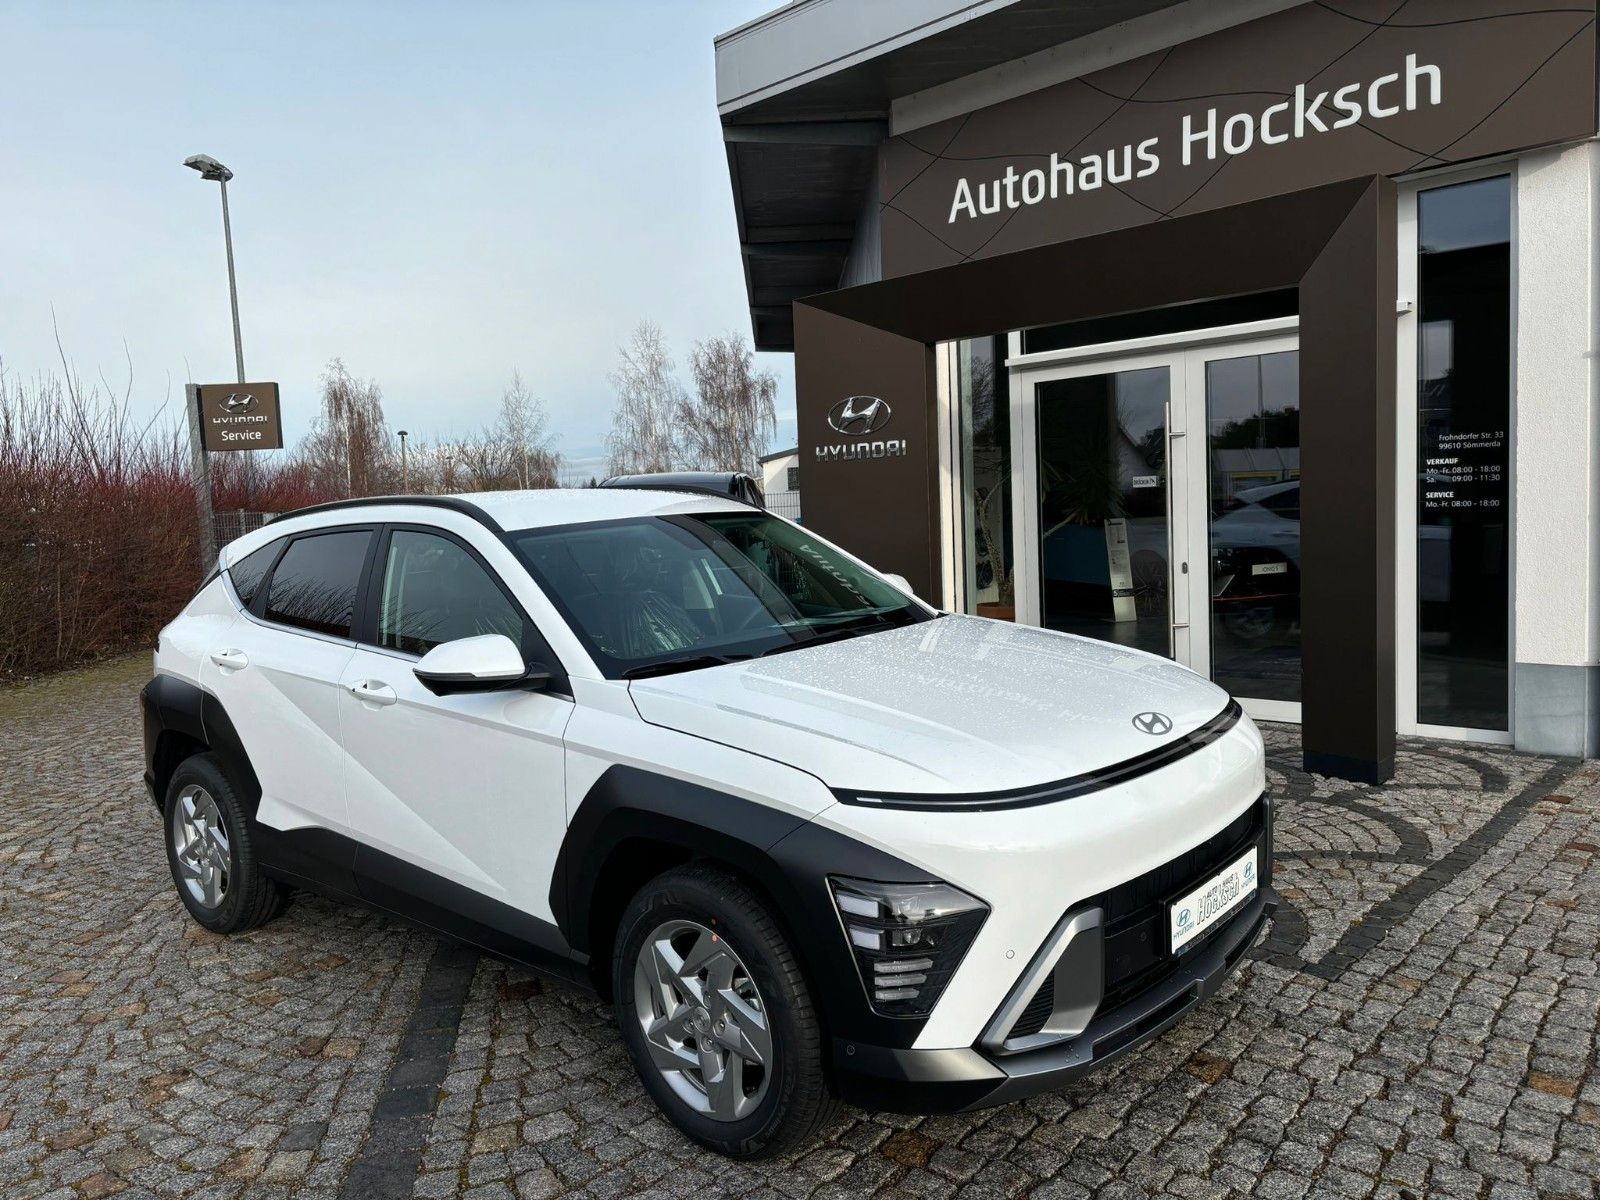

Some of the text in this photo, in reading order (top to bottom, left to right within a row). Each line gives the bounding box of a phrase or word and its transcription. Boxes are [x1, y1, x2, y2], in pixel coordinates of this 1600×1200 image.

[948, 53, 1442, 224] Autohaus Hocksch
[221, 430, 262, 441] Service
[1439, 433, 1479, 441] Frohndorfer
[815, 439, 907, 462] HYUNDAI
